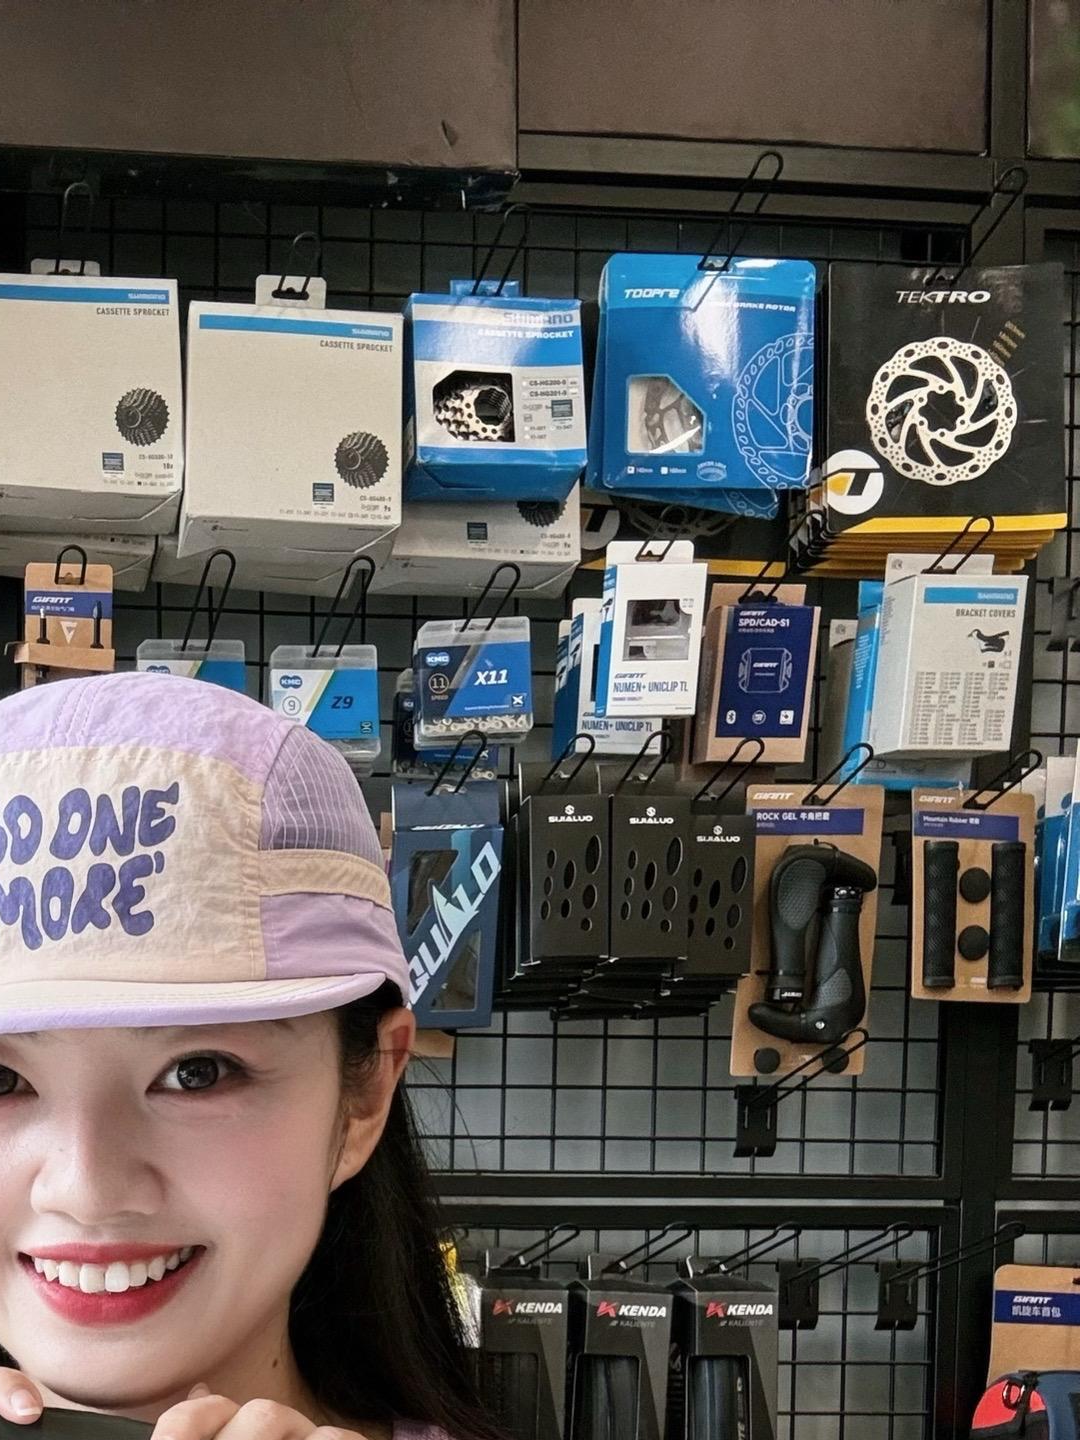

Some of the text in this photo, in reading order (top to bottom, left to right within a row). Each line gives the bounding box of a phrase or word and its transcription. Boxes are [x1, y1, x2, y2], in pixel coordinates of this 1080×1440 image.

[895, 289, 992, 304] TEKTRO
[96, 307, 170, 316] CASSETTE SPROCKET
[503, 311, 574, 324] SHIMANO
[524, 330, 574, 339] SPROCKET
[320, 339, 393, 353] CASSETTE SPROCKET
[32, 596, 74, 604] GIANT
[955, 608, 1016, 619] BRACKET COVERS
[738, 618, 790, 627] SPD/CAD-S1
[426, 655, 450, 663] KMC
[279, 678, 303, 687] KMC
[431, 677, 447, 689] 11
[473, 669, 509, 686] X11
[613, 680, 688, 693] NUMEN+ UNICLIP TL
[330, 695, 354, 710] Z9
[581, 720, 654, 733] NUMEN+ UNICLIP TL
[752, 792, 794, 801] GIANT
[49, 781, 180, 861] ONE
[756, 812, 780, 821] ROCK
[781, 812, 798, 821] GEL
[1012, 1295, 1054, 1304] GIANT
[514, 1302, 564, 1315] KENDA
[617, 1304, 668, 1318] KENDA
[726, 1303, 774, 1317] KENDA
